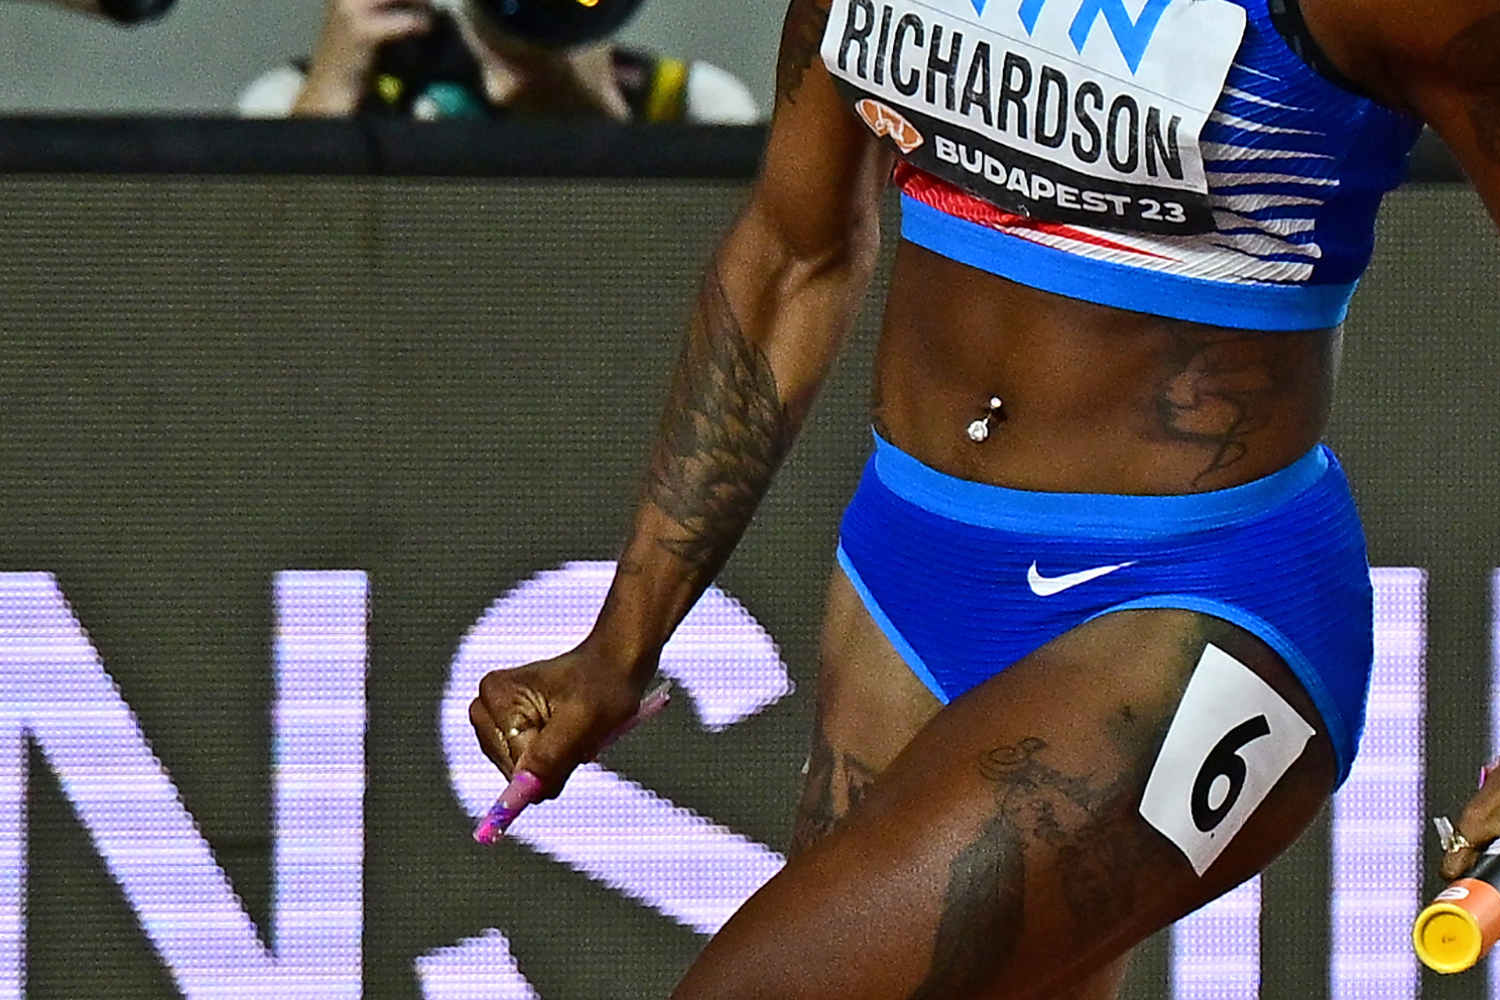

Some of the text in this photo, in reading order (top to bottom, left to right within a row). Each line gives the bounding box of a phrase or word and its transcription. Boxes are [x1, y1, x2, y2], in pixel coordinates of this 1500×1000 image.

[933, 135, 1187, 224] BUDAPEST 23
[1190, 713, 1271, 833] 6
